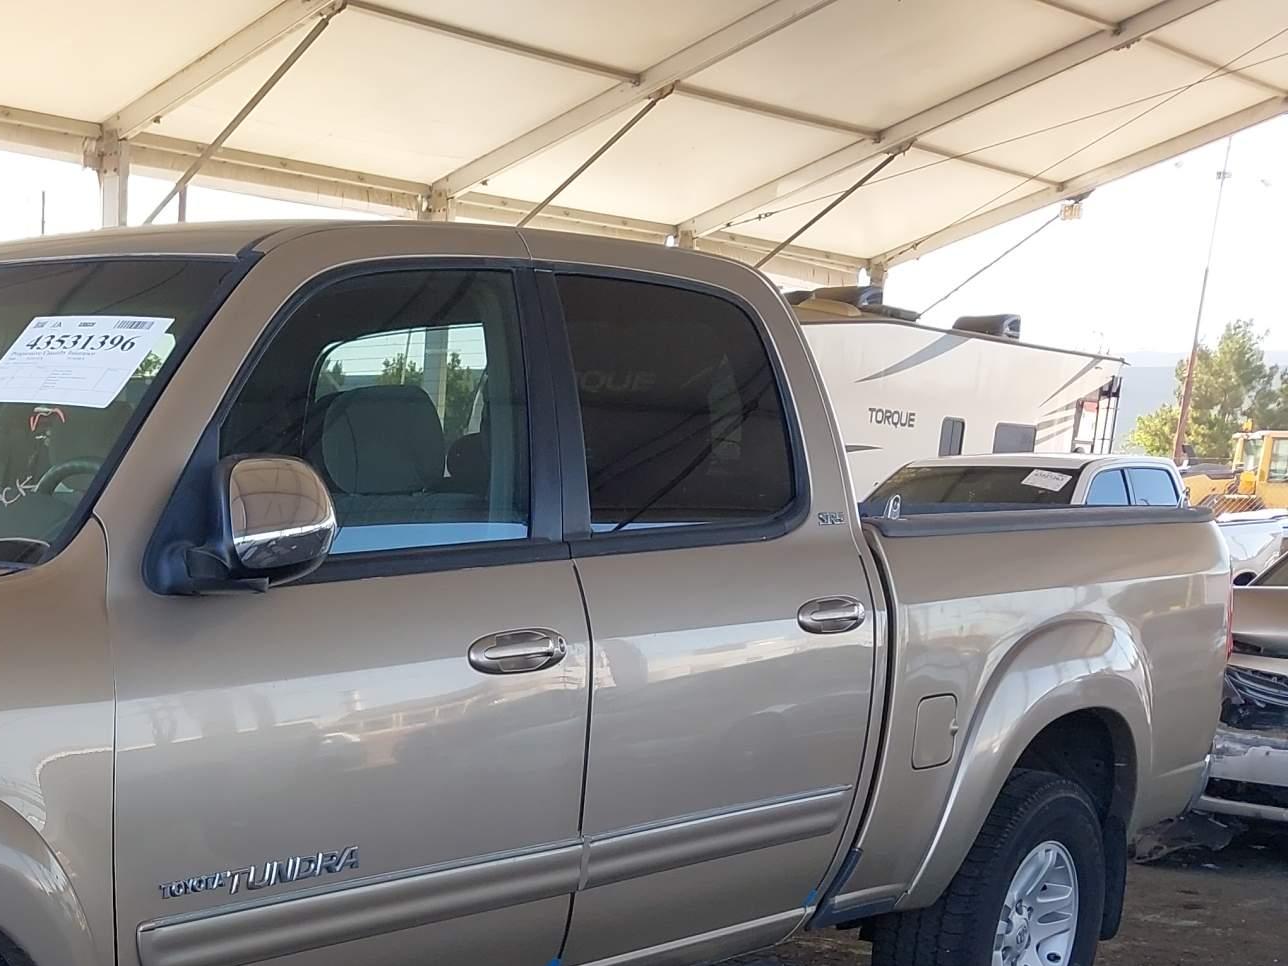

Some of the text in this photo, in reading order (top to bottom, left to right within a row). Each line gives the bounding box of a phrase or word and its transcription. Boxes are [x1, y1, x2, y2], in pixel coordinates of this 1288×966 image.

[26, 334, 143, 352] 43531396
[868, 407, 916, 428] TORQUE
[159, 845, 360, 899] TOYOTA TUNDRA
